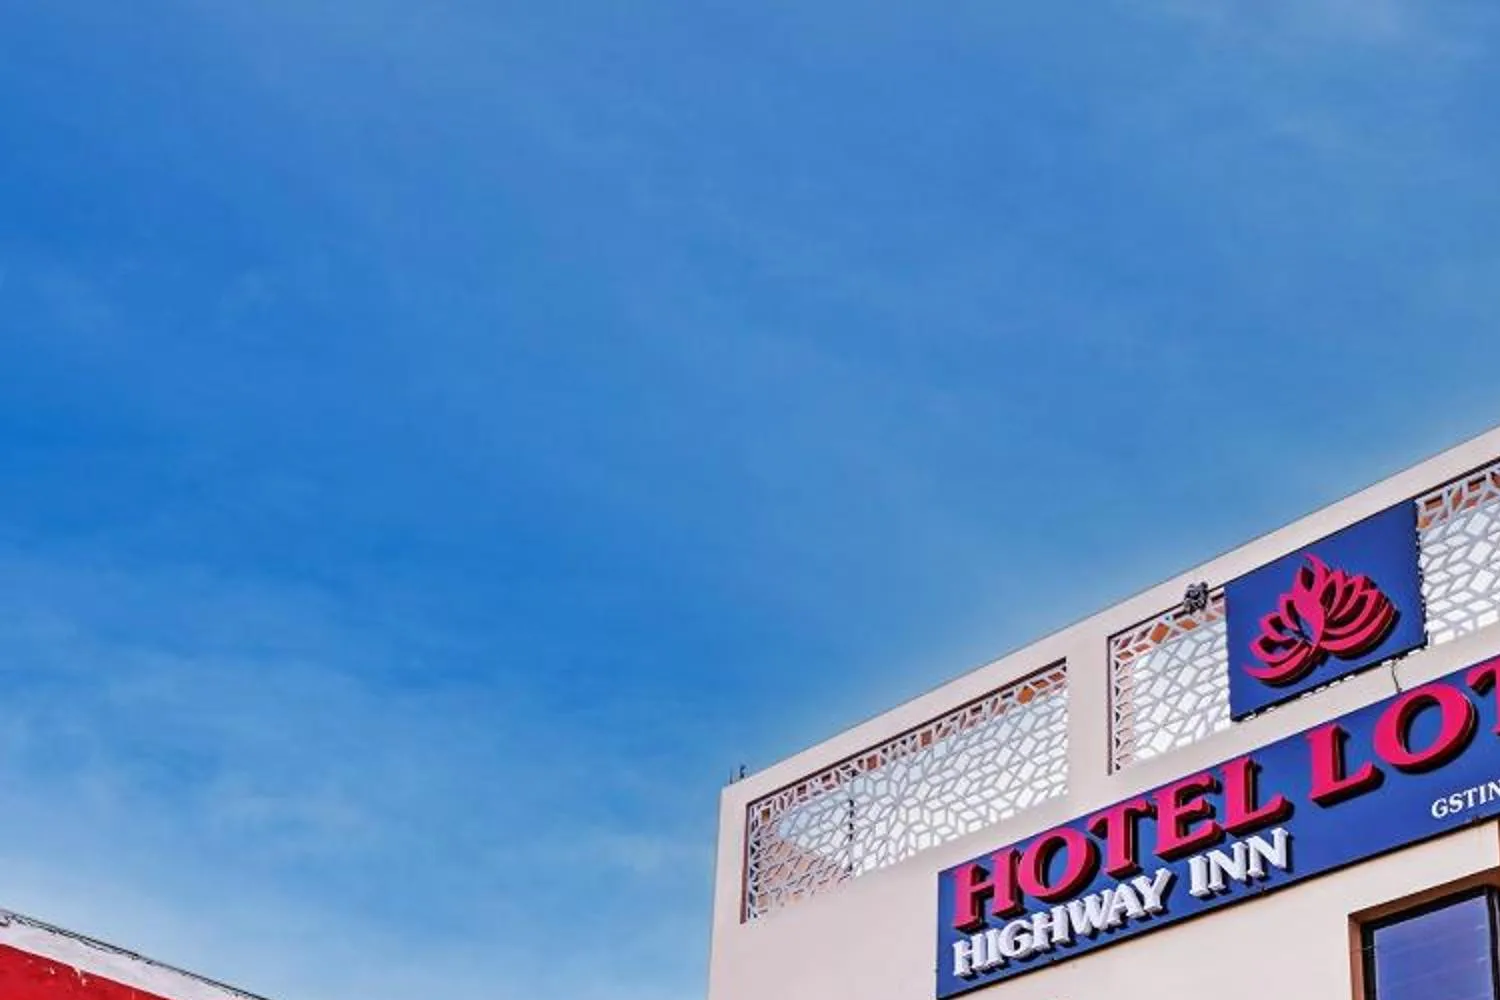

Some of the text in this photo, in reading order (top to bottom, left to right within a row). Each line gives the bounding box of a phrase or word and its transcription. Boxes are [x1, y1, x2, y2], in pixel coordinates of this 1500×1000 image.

[952, 757, 1290, 930] HOTEL
[952, 827, 1291, 977] HIGHWAY INN
